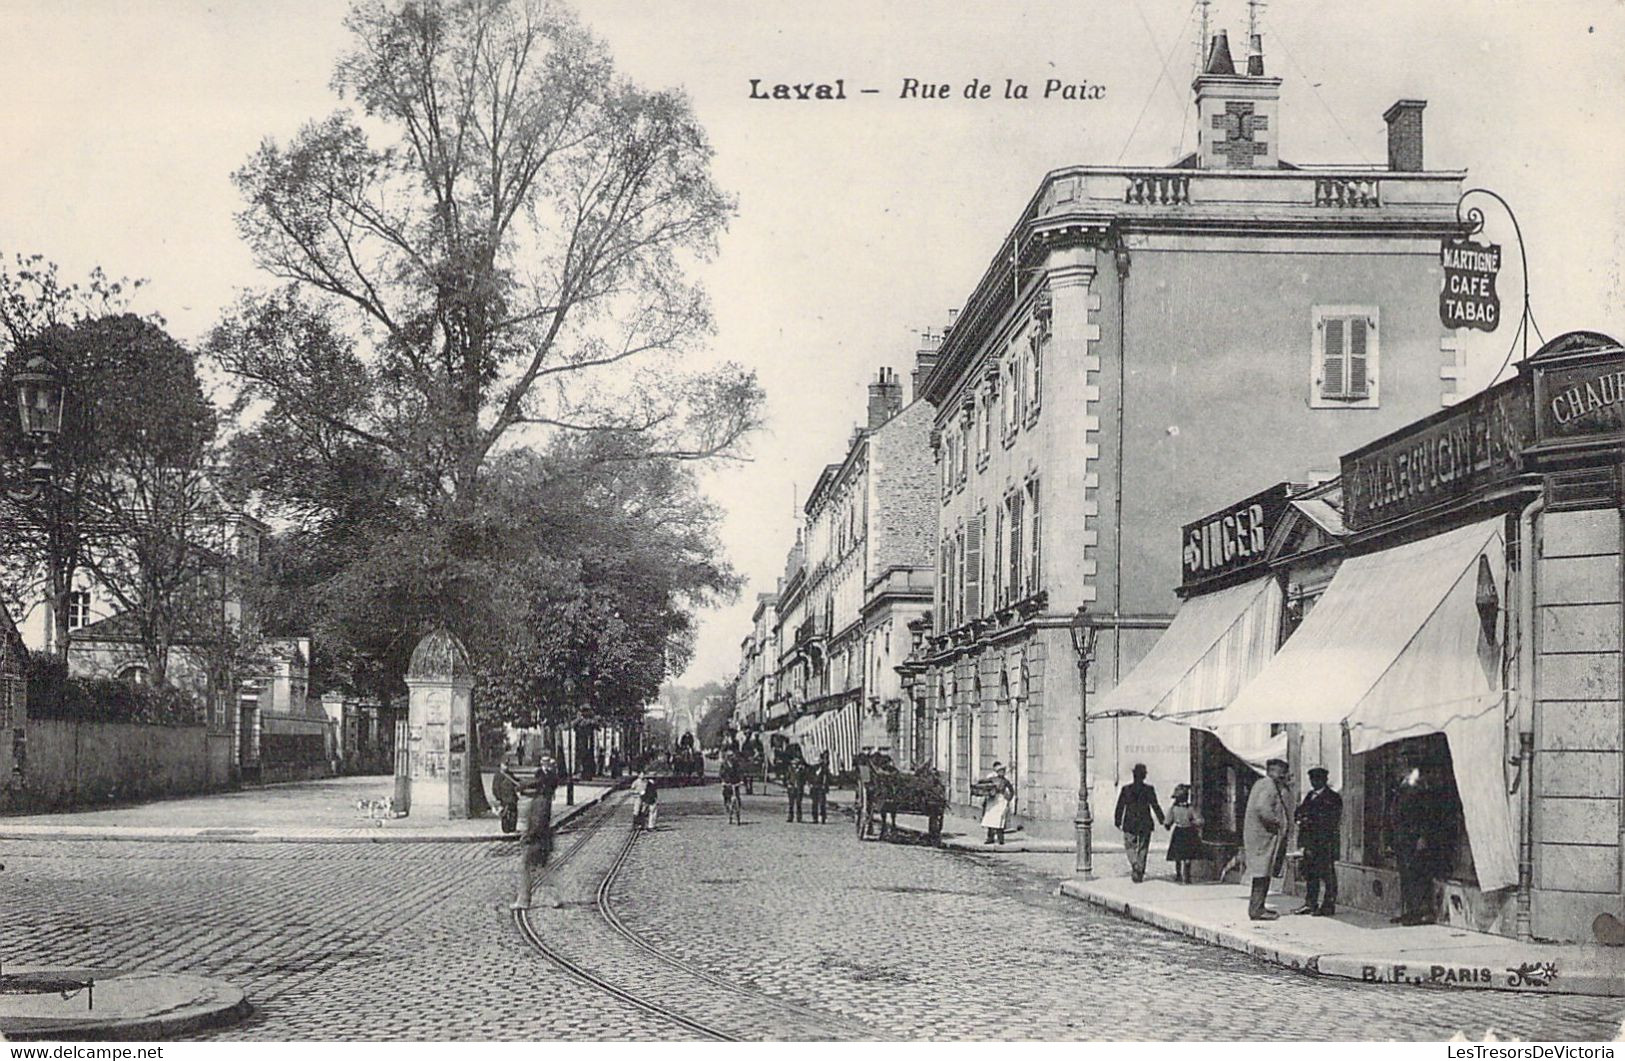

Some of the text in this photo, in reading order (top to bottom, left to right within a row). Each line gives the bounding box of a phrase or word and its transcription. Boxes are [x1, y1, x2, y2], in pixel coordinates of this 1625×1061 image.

[1443, 247, 1499, 273] MARTIGNÉ
[1450, 273, 1490, 297] CAFÉ
[1446, 299, 1495, 323] TABAC
[1184, 504, 1264, 572] SINGER
